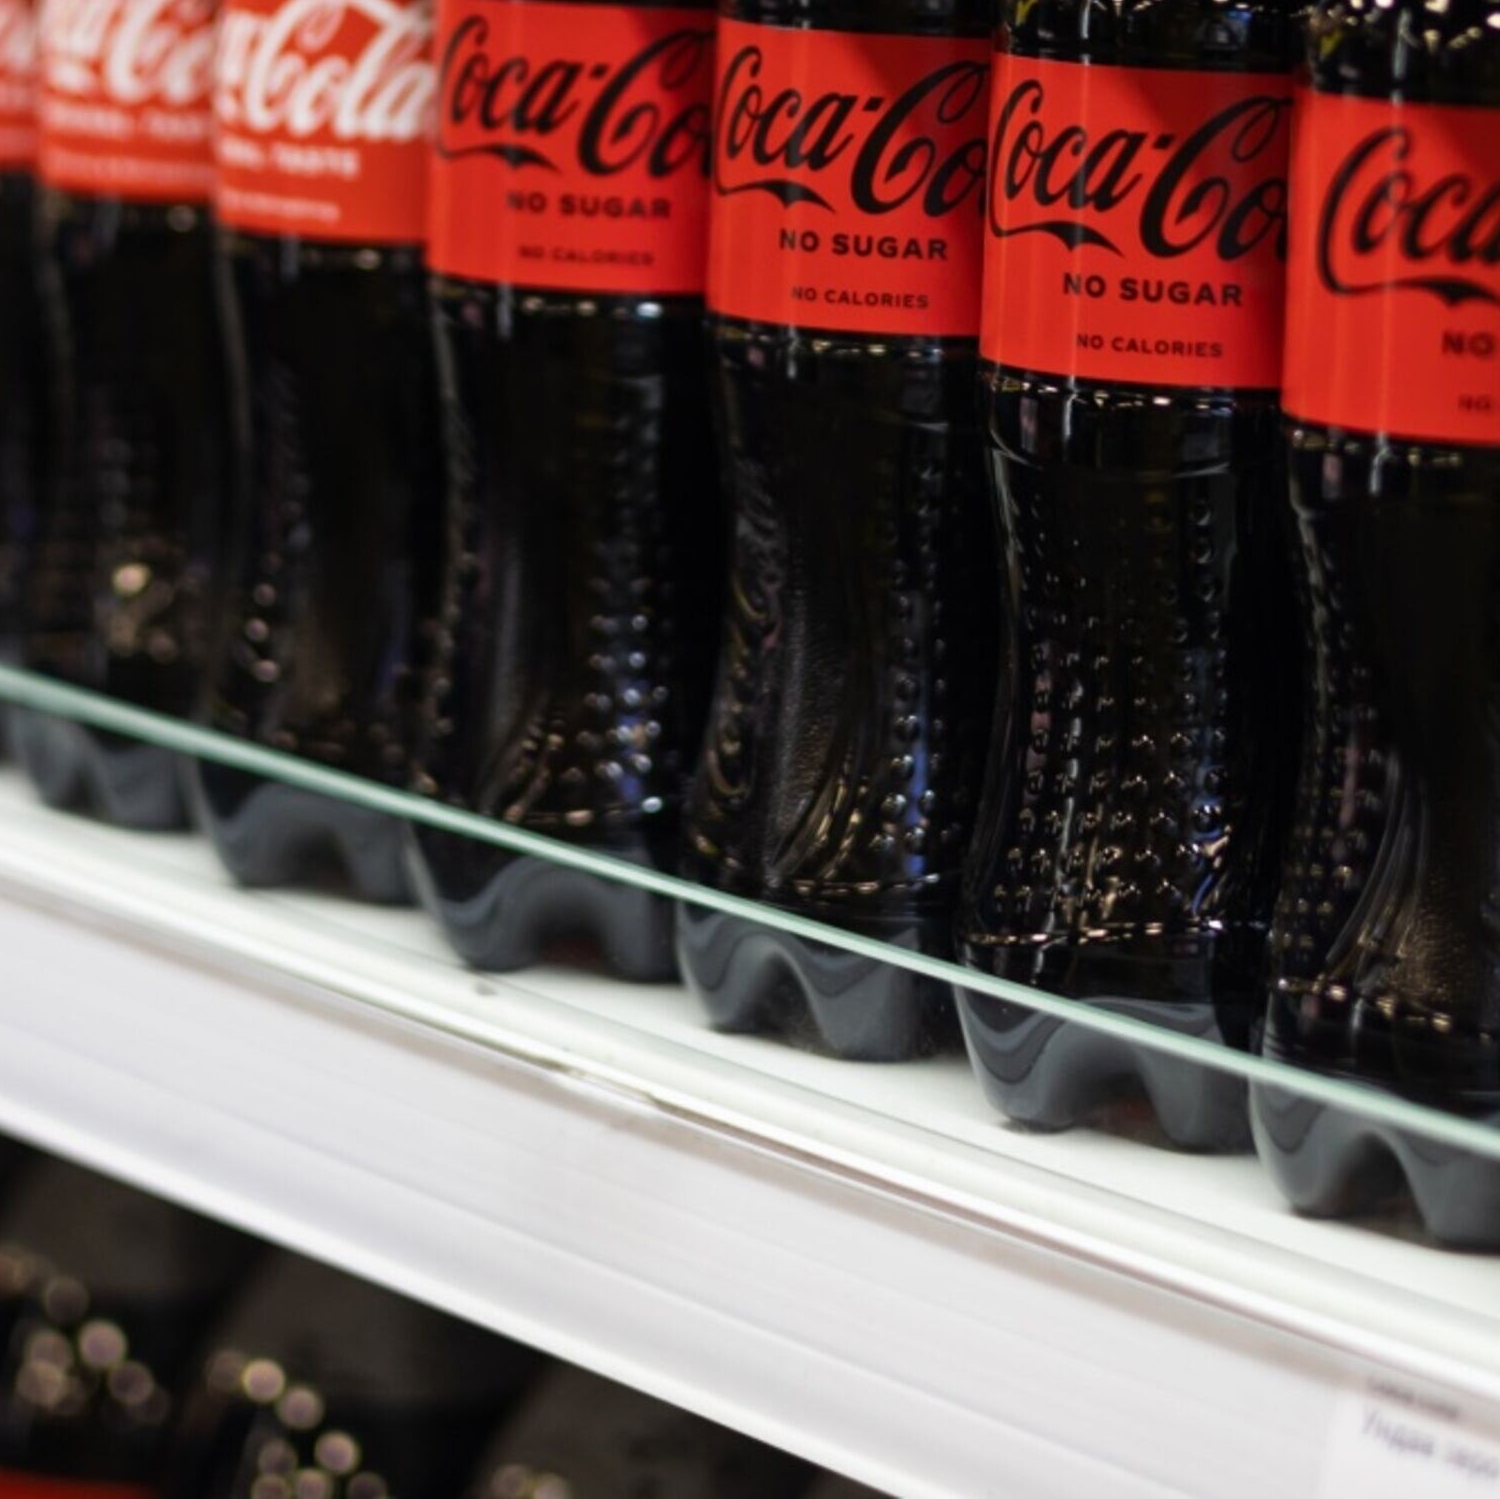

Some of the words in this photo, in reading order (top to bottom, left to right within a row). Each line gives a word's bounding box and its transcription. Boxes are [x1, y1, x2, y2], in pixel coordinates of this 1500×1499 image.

[438, 15, 713, 178] Coca-Co
[713, 45, 988, 218] Coca-Co
[988, 79, 1290, 261] Coca-Co
[506, 190, 547, 214] NO
[558, 192, 671, 220] SUGAR
[553, 248, 655, 267] CALORIES
[779, 228, 819, 252] NO
[831, 234, 949, 261] SUGAR
[791, 286, 817, 303] NO
[823, 287, 930, 311] CALORIES
[1062, 272, 1106, 299] NO
[1119, 277, 1244, 308] SUGAR
[1076, 333, 1105, 351] NO
[1111, 336, 1224, 360] CALORIES
[1442, 329, 1497, 358] NO
